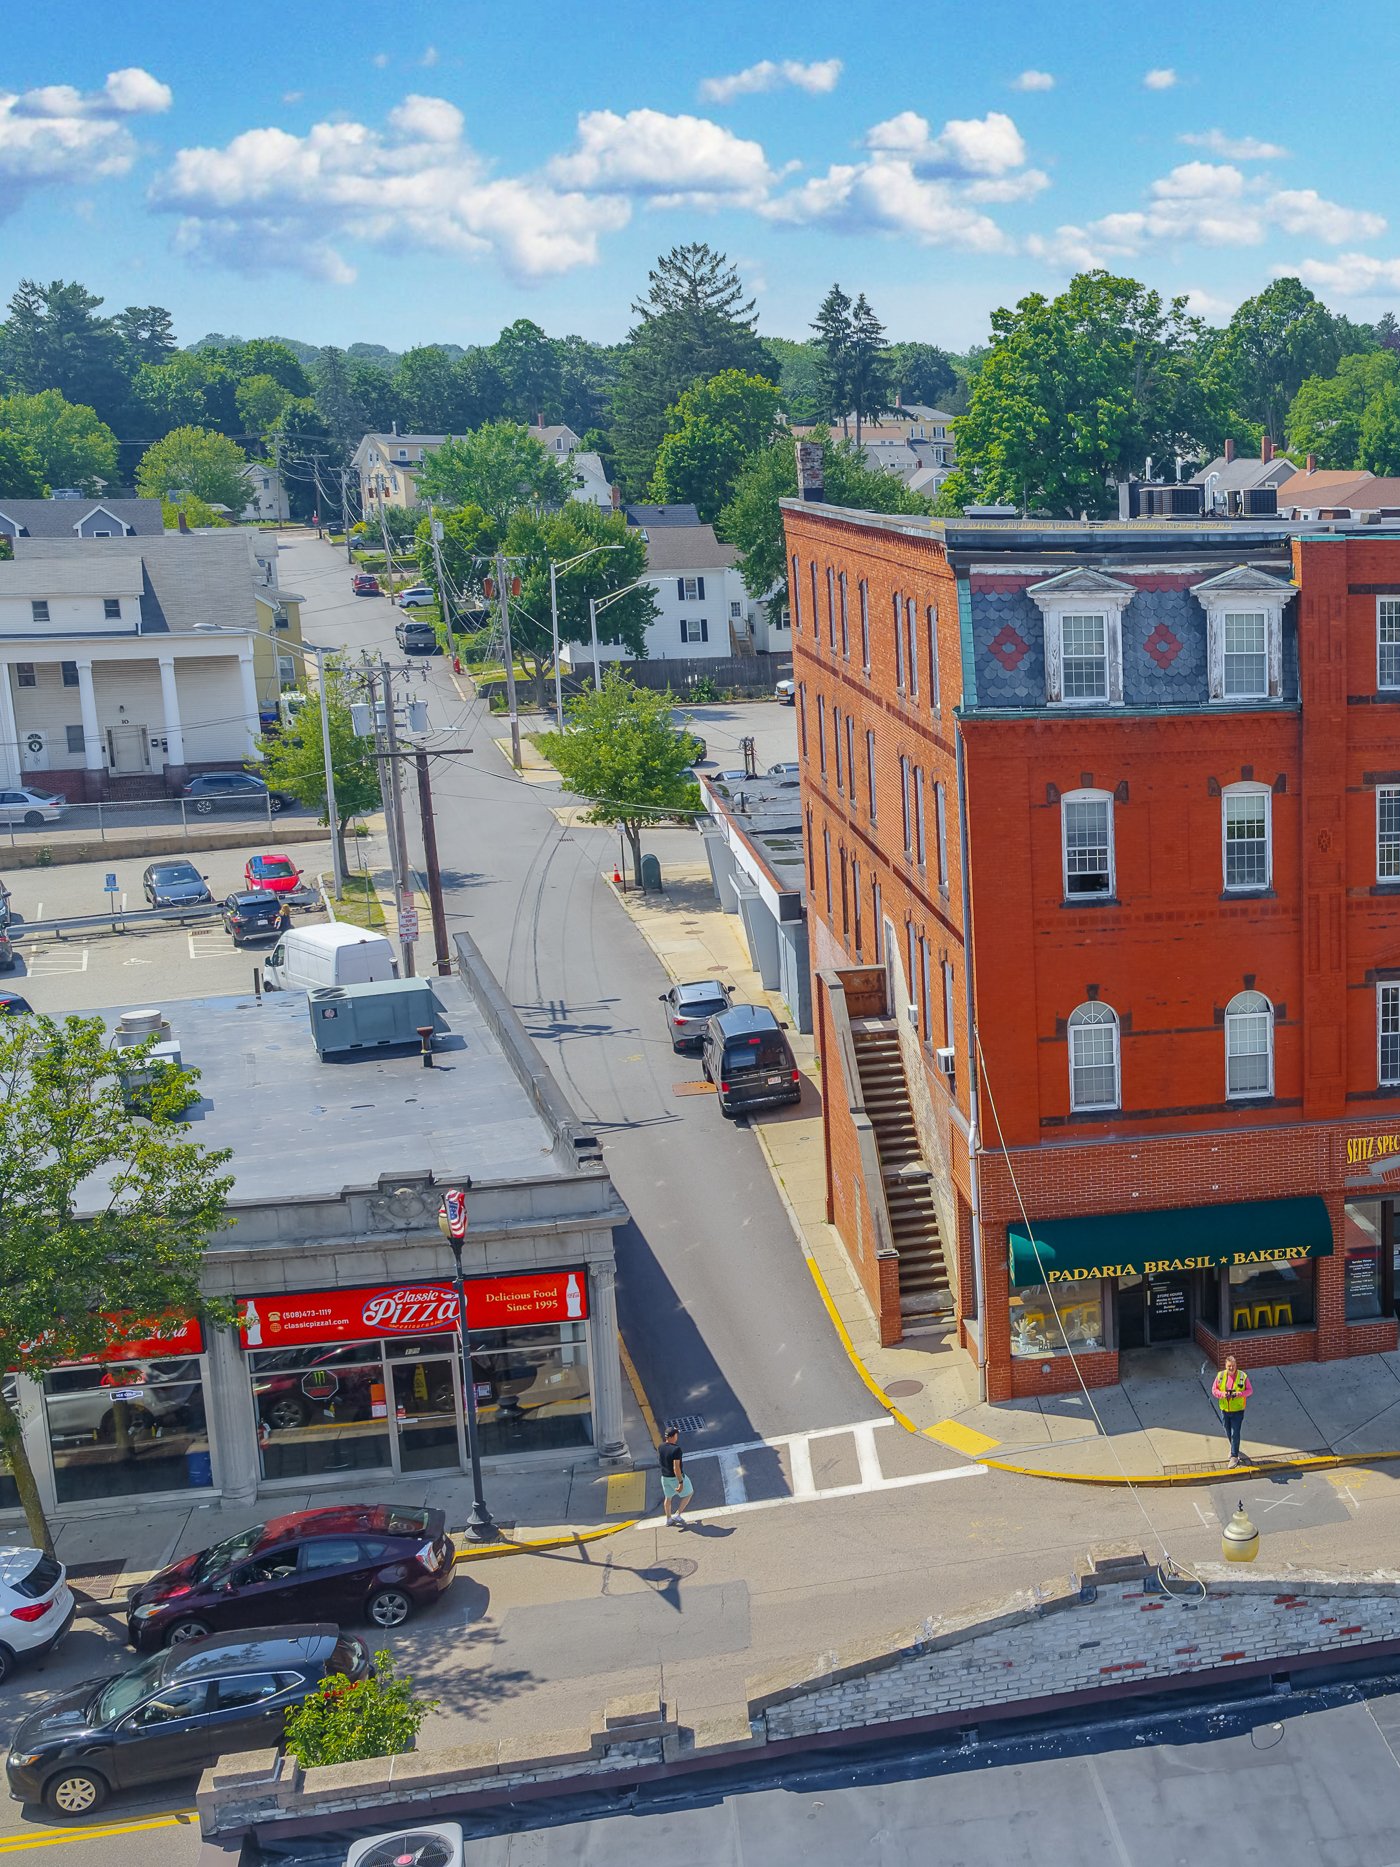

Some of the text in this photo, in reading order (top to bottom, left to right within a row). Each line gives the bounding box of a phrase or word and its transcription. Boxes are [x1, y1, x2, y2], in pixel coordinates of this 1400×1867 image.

[1346, 1138, 1374, 1164] SEITZ
[1048, 1245, 1312, 1283] PADARIA BRASIL BAKERY
[392, 1290, 439, 1304] Classic
[486, 1291, 531, 1303] Delicious
[533, 1288, 558, 1299] Food
[506, 1299, 558, 1312] Since 1995
[282, 1308, 332, 1320] (508)473-1119
[283, 1317, 350, 1330] classicpizza1.com
